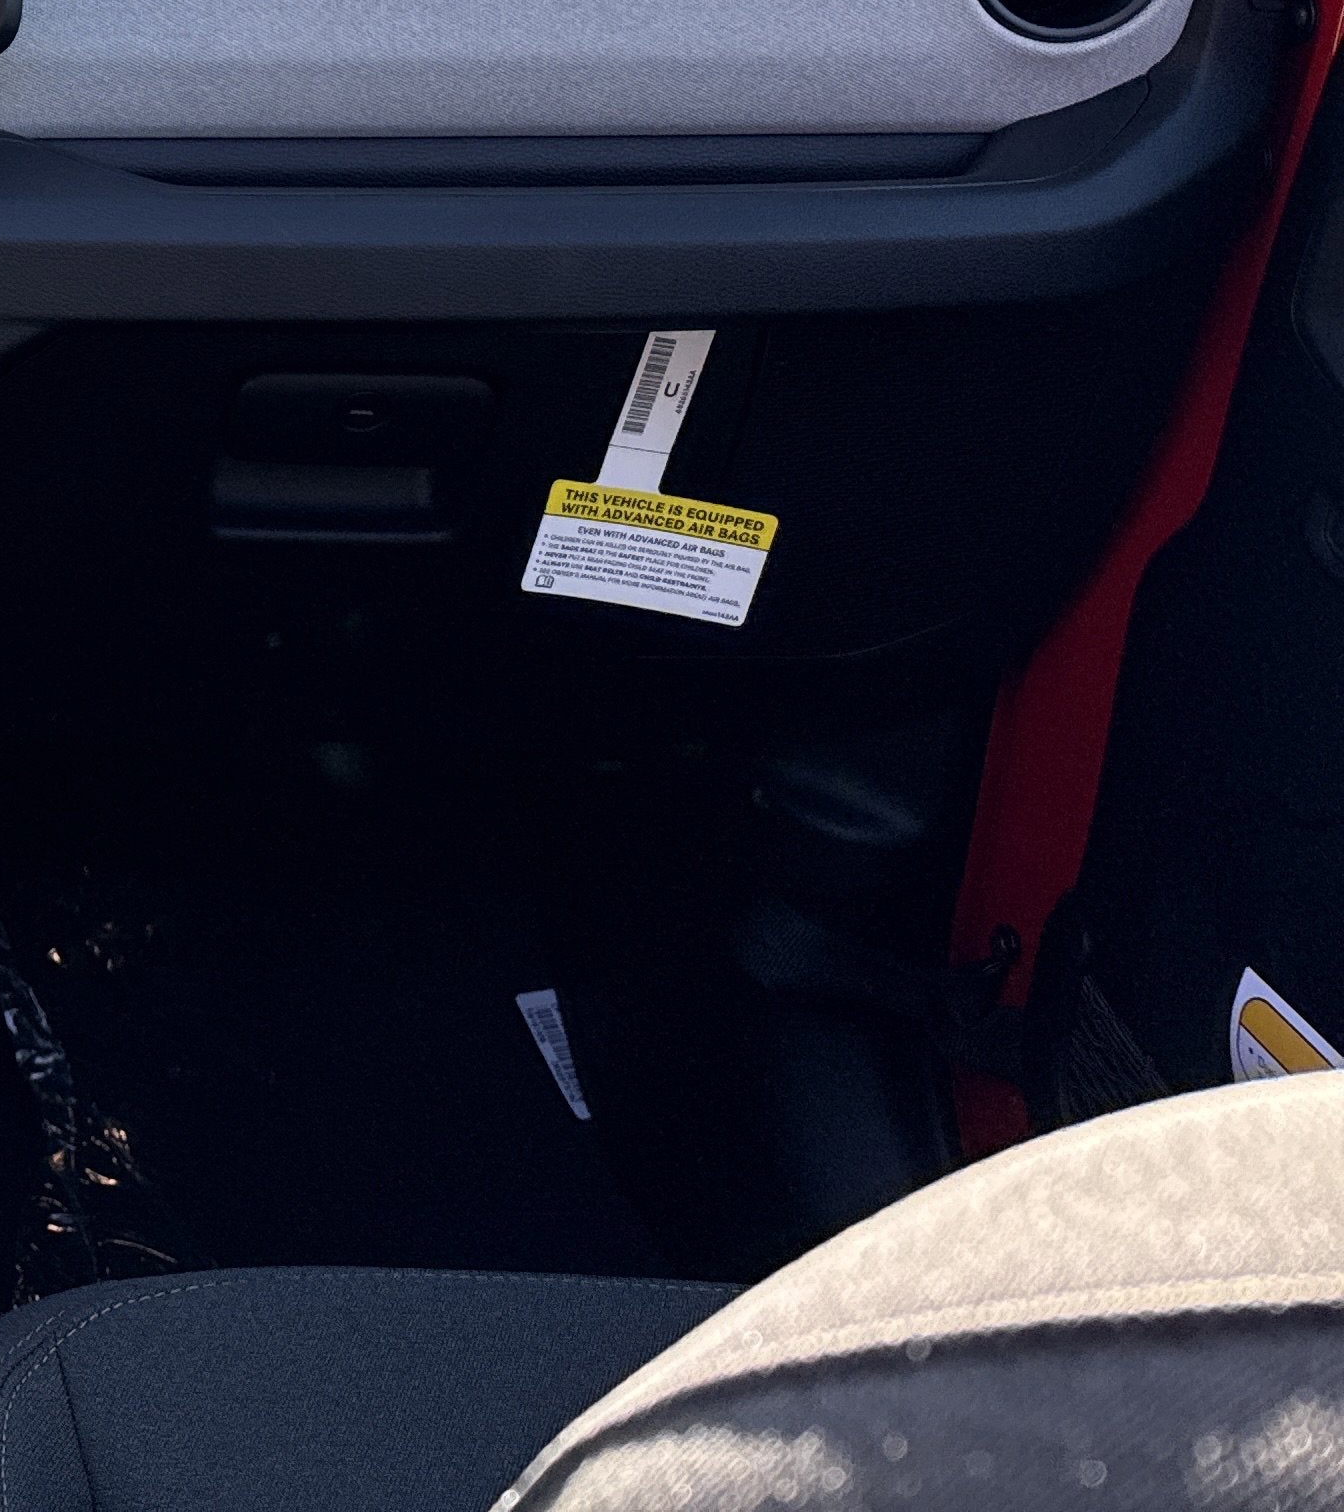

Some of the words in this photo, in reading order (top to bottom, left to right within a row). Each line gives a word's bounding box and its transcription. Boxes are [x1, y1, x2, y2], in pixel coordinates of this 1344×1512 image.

[664, 382, 681, 397] U
[561, 502, 599, 518] WITH
[601, 509, 685, 531] ADVANCED
[688, 522, 715, 537] AIR
[718, 529, 761, 546] BAGS
[565, 488, 599, 503] THIS
[603, 494, 667, 512] VEHICLE
[668, 504, 683, 516] IS
[686, 507, 765, 532] EQUIPPED
[577, 525, 601, 537] EVEN
[603, 529, 628, 540] WITH
[628, 532, 681, 552] ADVANCED
[681, 542, 699, 553] AIR
[699, 545, 726, 558] BAGS
